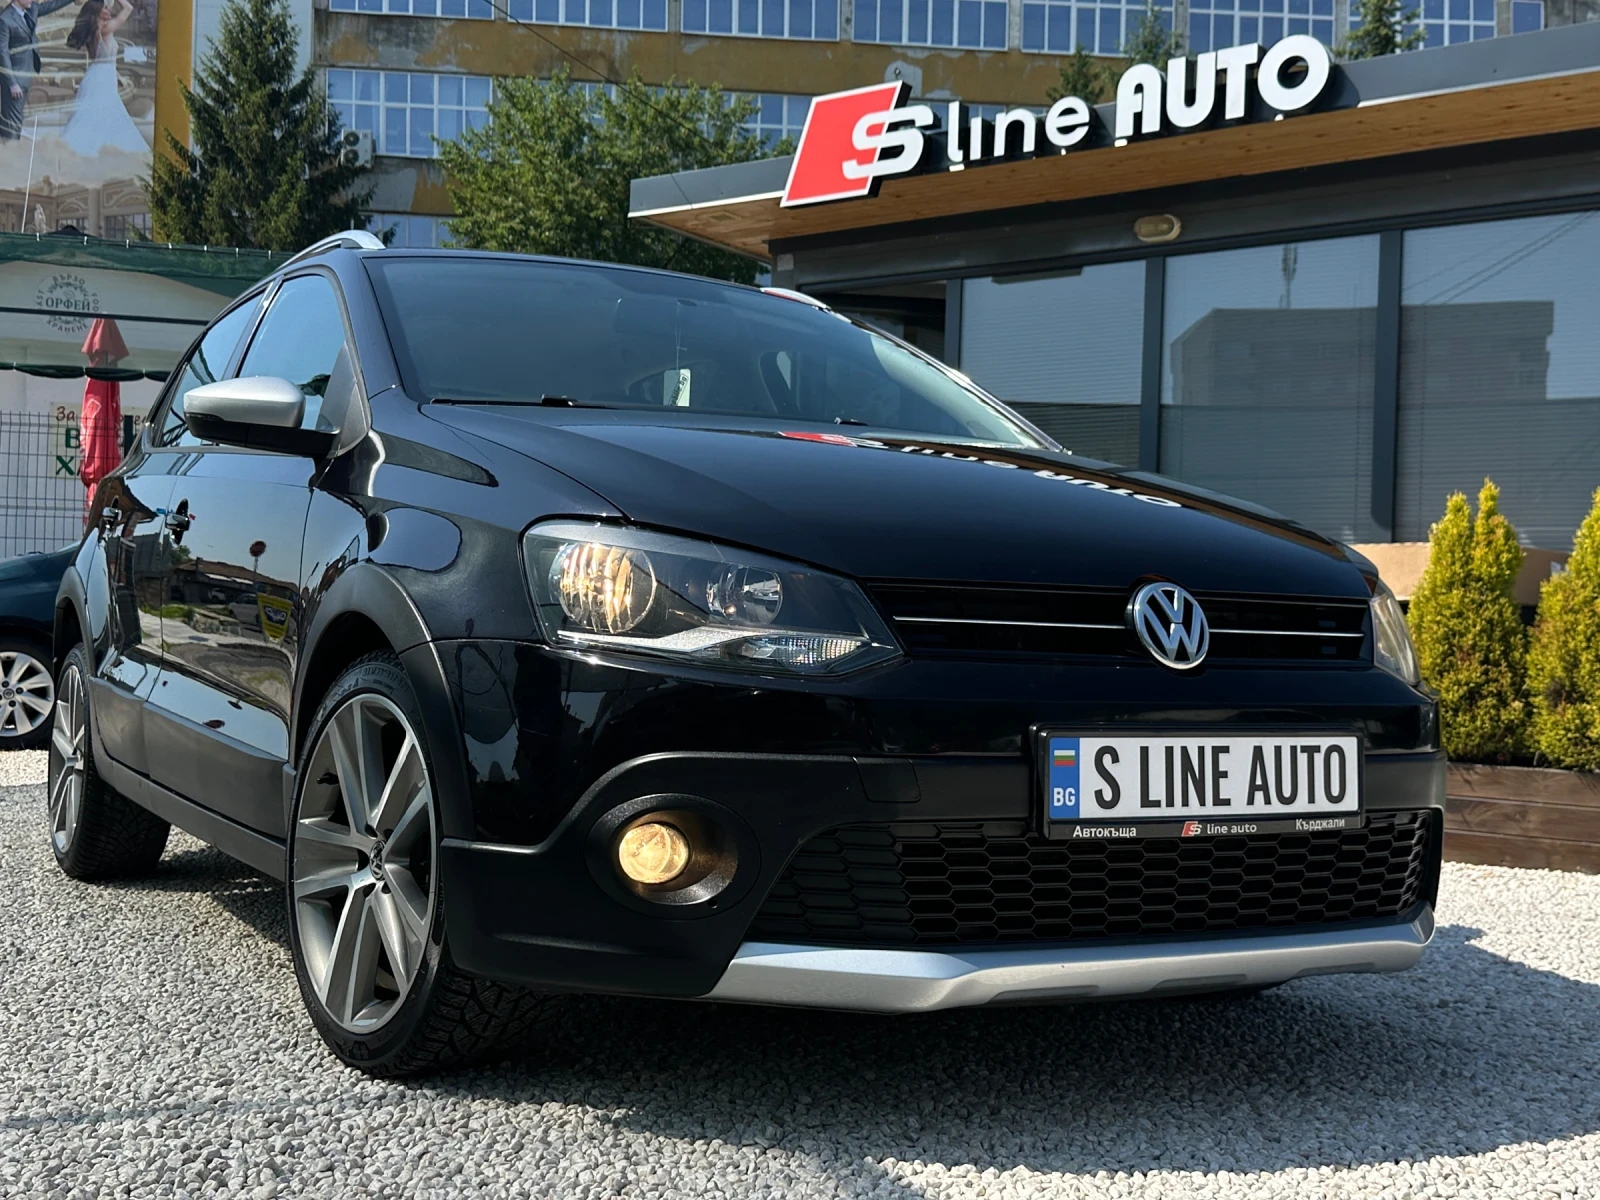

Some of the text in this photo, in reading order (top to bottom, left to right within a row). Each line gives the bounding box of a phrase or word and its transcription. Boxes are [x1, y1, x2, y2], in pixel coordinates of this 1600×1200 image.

[842, 34, 1331, 180] S line AUTO
[1094, 744, 1347, 810] S LINE AUTO
[1053, 787, 1076, 806] BG
[1072, 825, 1137, 838] Автокъща
[1206, 823, 1228, 834] line
[1230, 824, 1257, 834] auto
[1295, 818, 1345, 832] Кърджали
